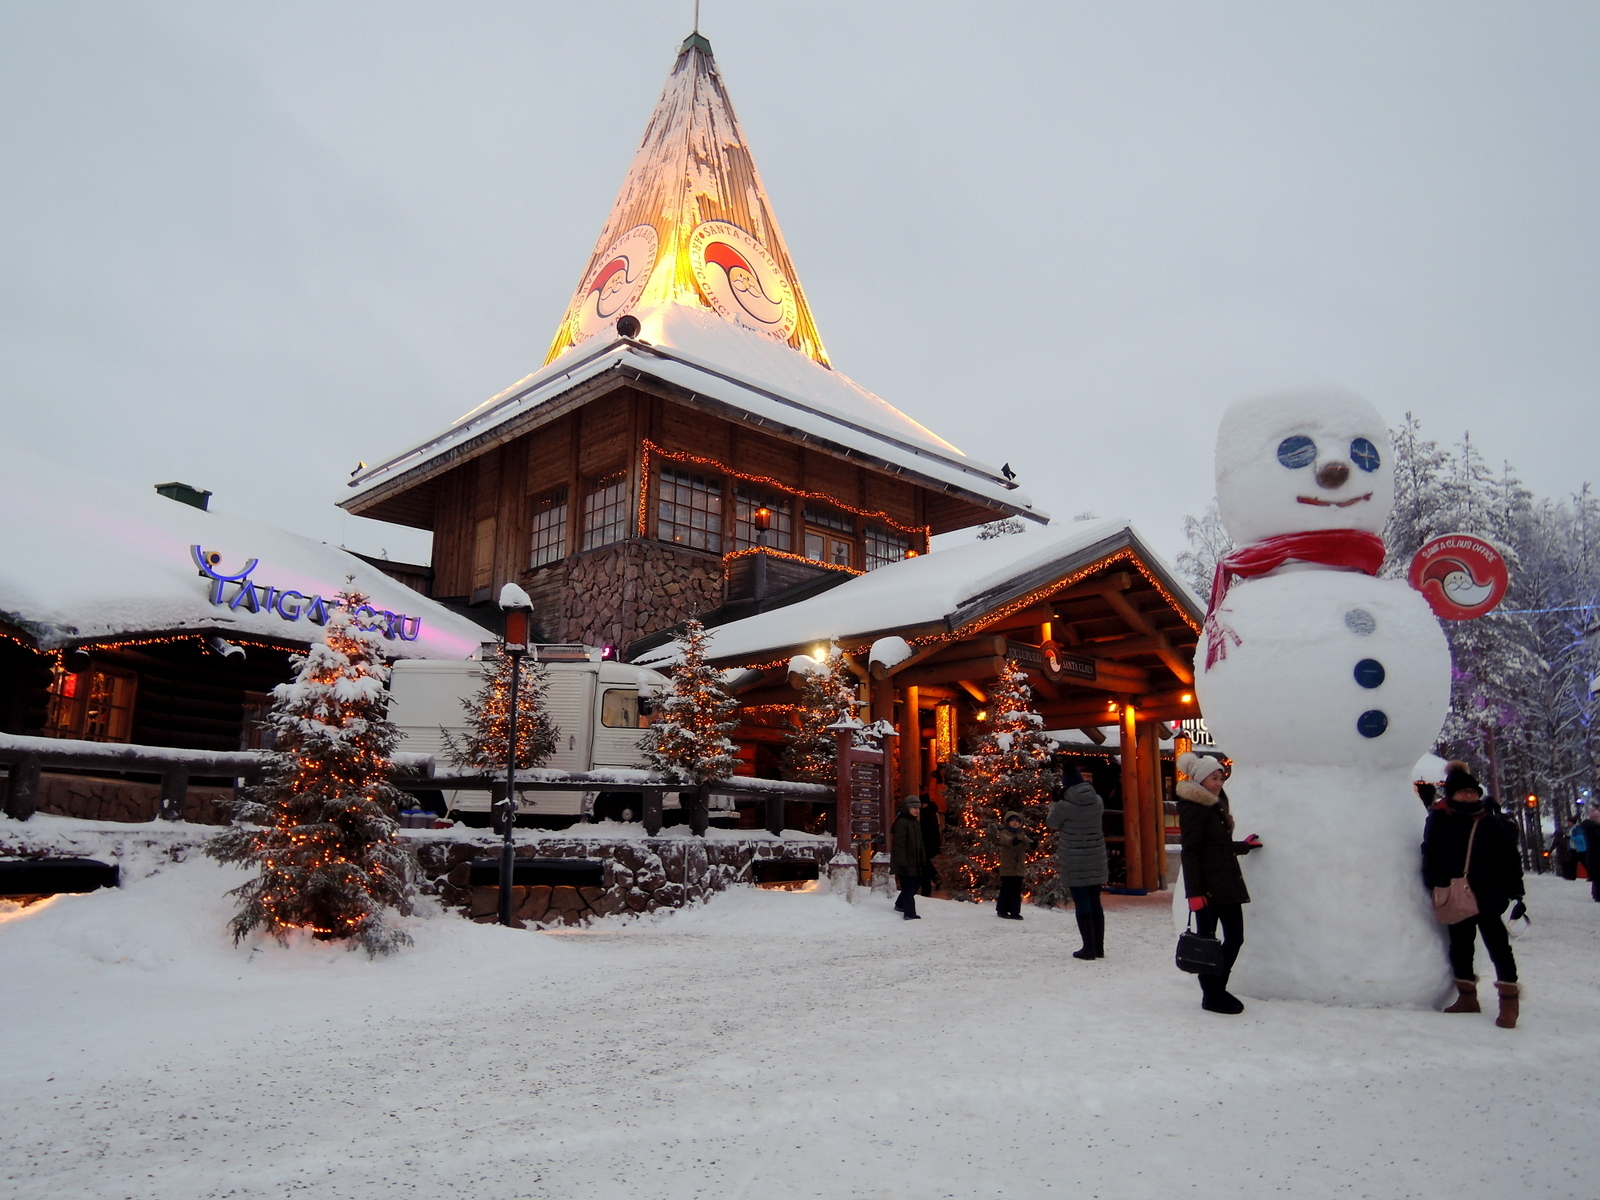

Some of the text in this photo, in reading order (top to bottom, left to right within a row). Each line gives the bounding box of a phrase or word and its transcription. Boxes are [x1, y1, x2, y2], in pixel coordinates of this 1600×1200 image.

[598, 228, 656, 292] SANTA CLAUS OFFICE
[692, 235, 706, 280] ARCTIC
[703, 224, 740, 239] SANTA
[744, 236, 781, 275] CLAUS
[779, 279, 796, 327] OFFICE
[1421, 539, 1497, 563] SANTA CLAUS OFFICE
[203, 568, 421, 641] TAIGAORU
[1062, 660, 1094, 675] SANTA CLAUS
